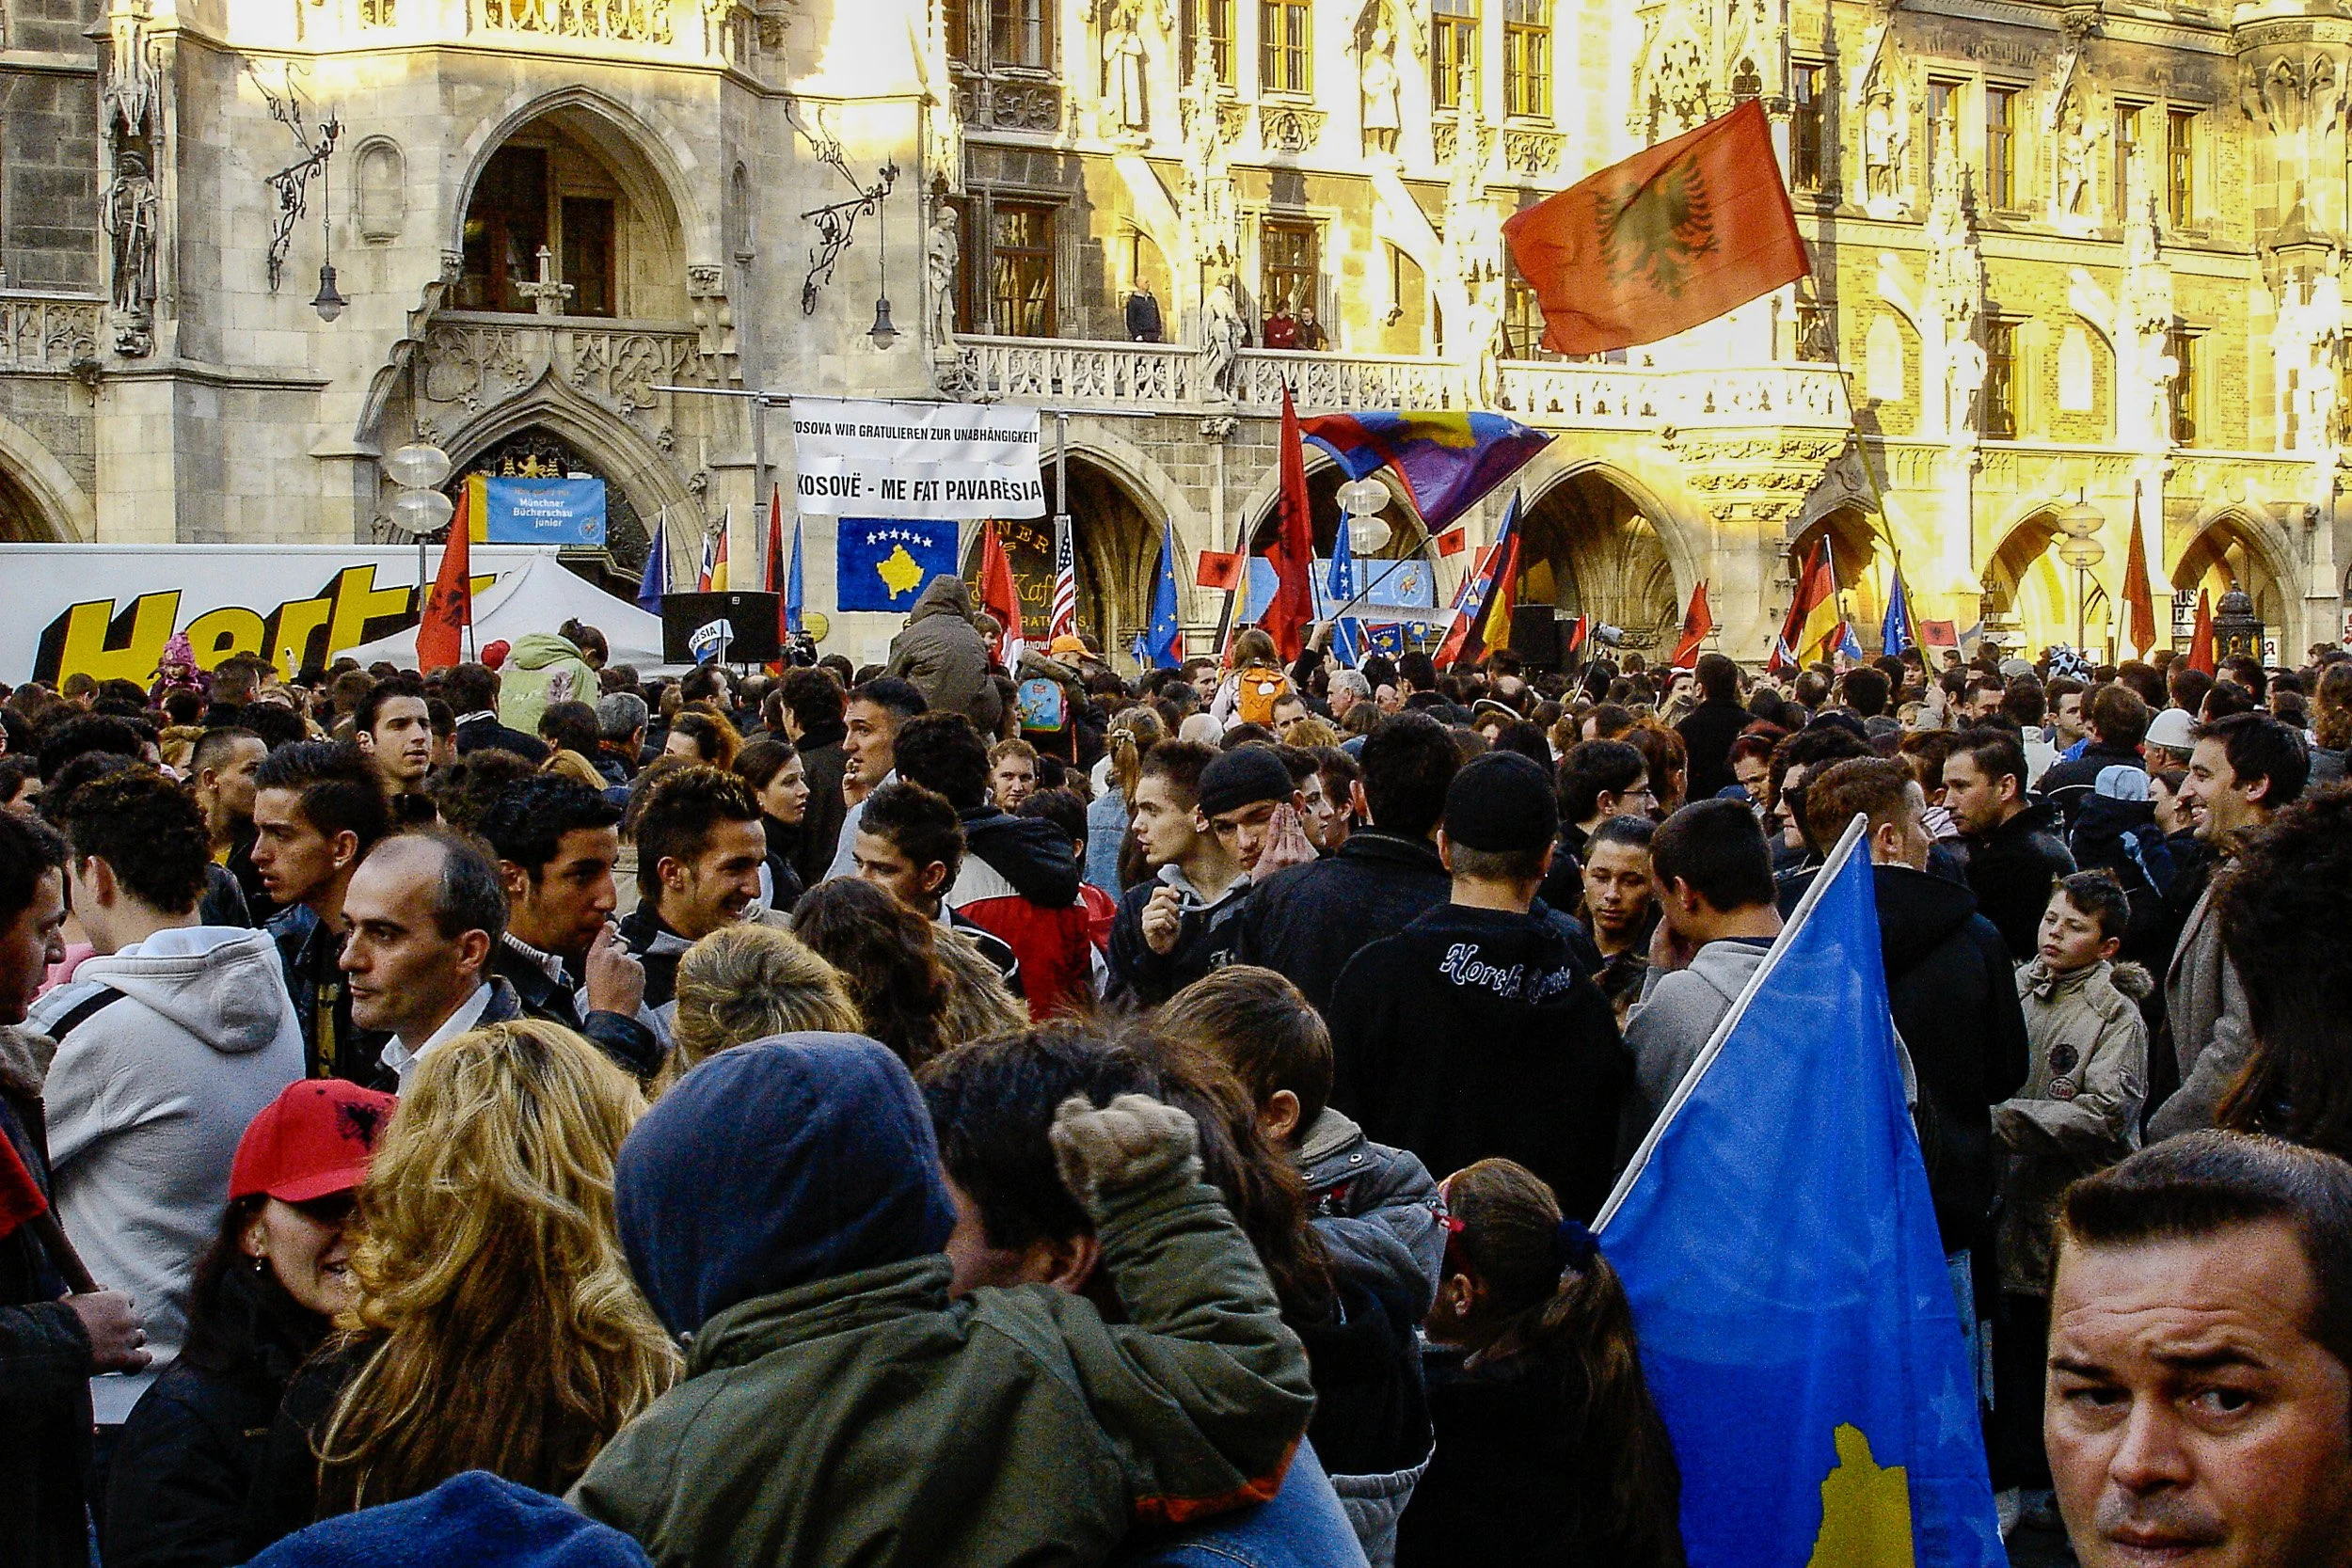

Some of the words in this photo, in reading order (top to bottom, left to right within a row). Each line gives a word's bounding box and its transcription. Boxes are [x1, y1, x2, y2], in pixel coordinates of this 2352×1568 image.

[793, 420, 832, 435] OSOVA
[835, 422, 856, 436] WIR
[859, 425, 929, 440] GRATULIEREN
[930, 428, 951, 440] ZUR
[954, 426, 1039, 443] UNABHÄNGIGKEIT
[797, 472, 862, 498] KOSOVË
[881, 479, 907, 500] ME
[913, 481, 939, 501] FAT
[946, 477, 1042, 501] PAVARËSIA
[519, 498, 564, 507] Münchner
[513, 507, 573, 517] Bücherschau
[534, 518, 563, 529] junior
[32, 563, 498, 698] Hert
